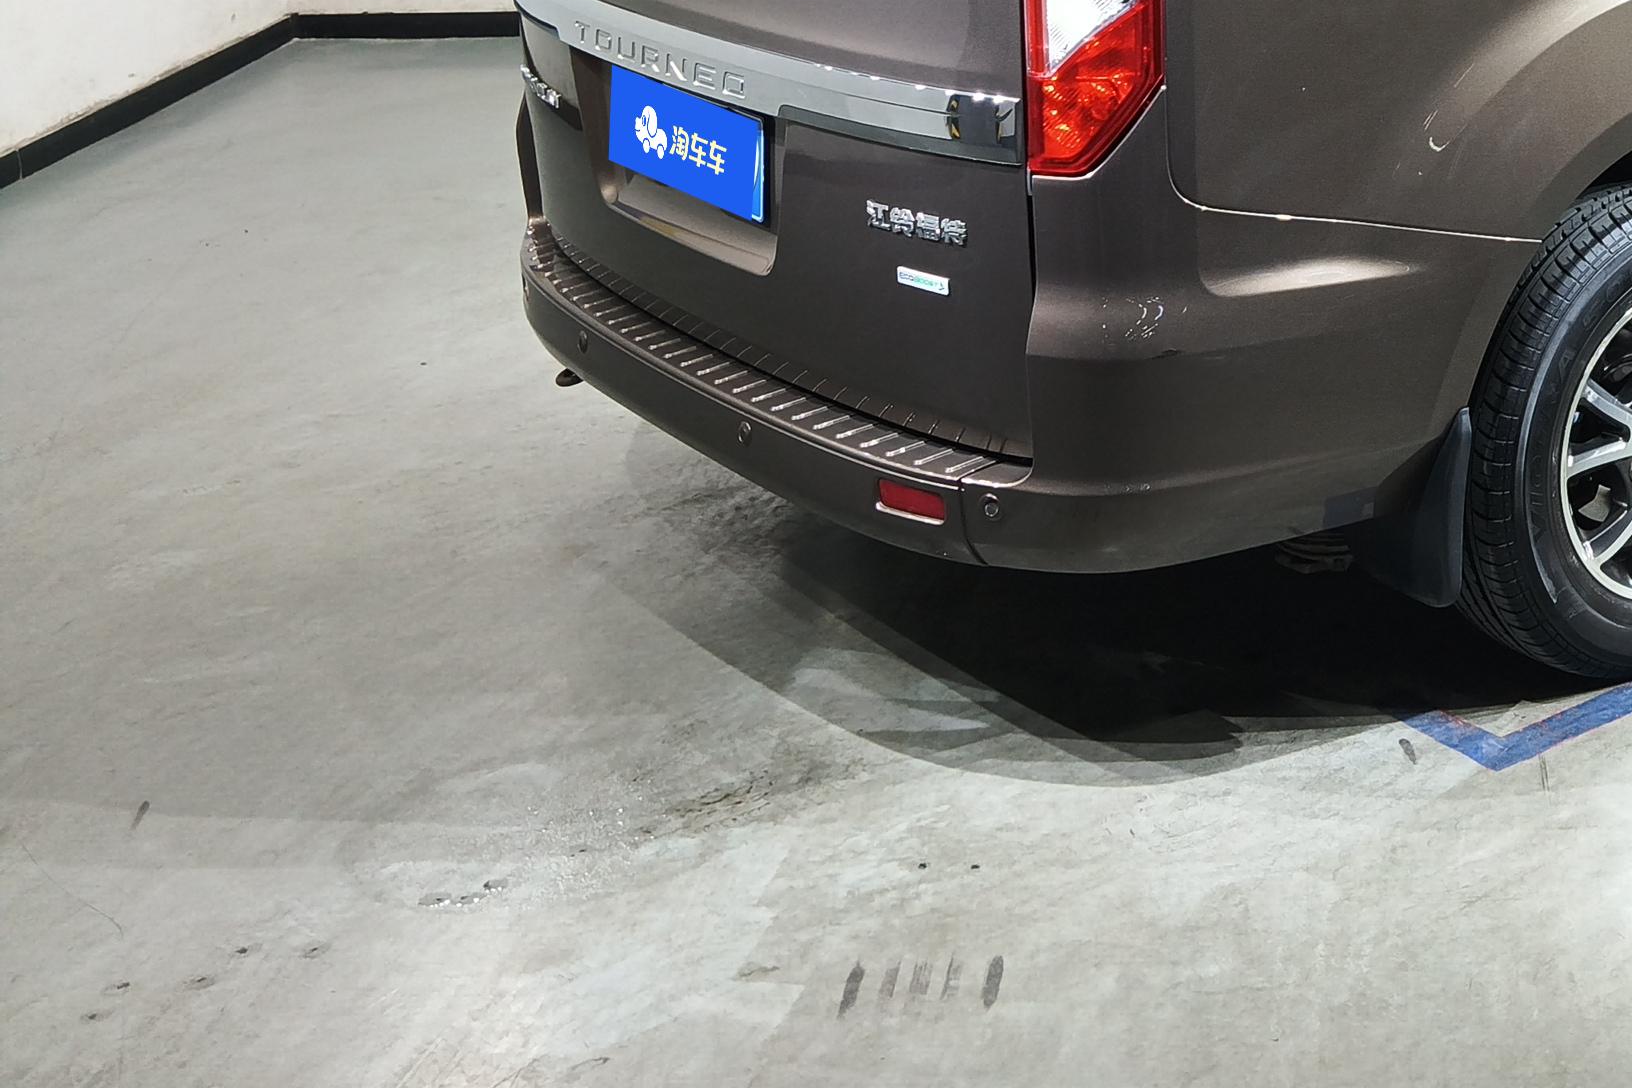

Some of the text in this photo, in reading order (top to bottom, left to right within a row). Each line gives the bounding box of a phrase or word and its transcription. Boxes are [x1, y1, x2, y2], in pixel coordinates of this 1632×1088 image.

[574, 20, 746, 100] TOURNEO
[866, 199, 969, 247] 江铃福特
